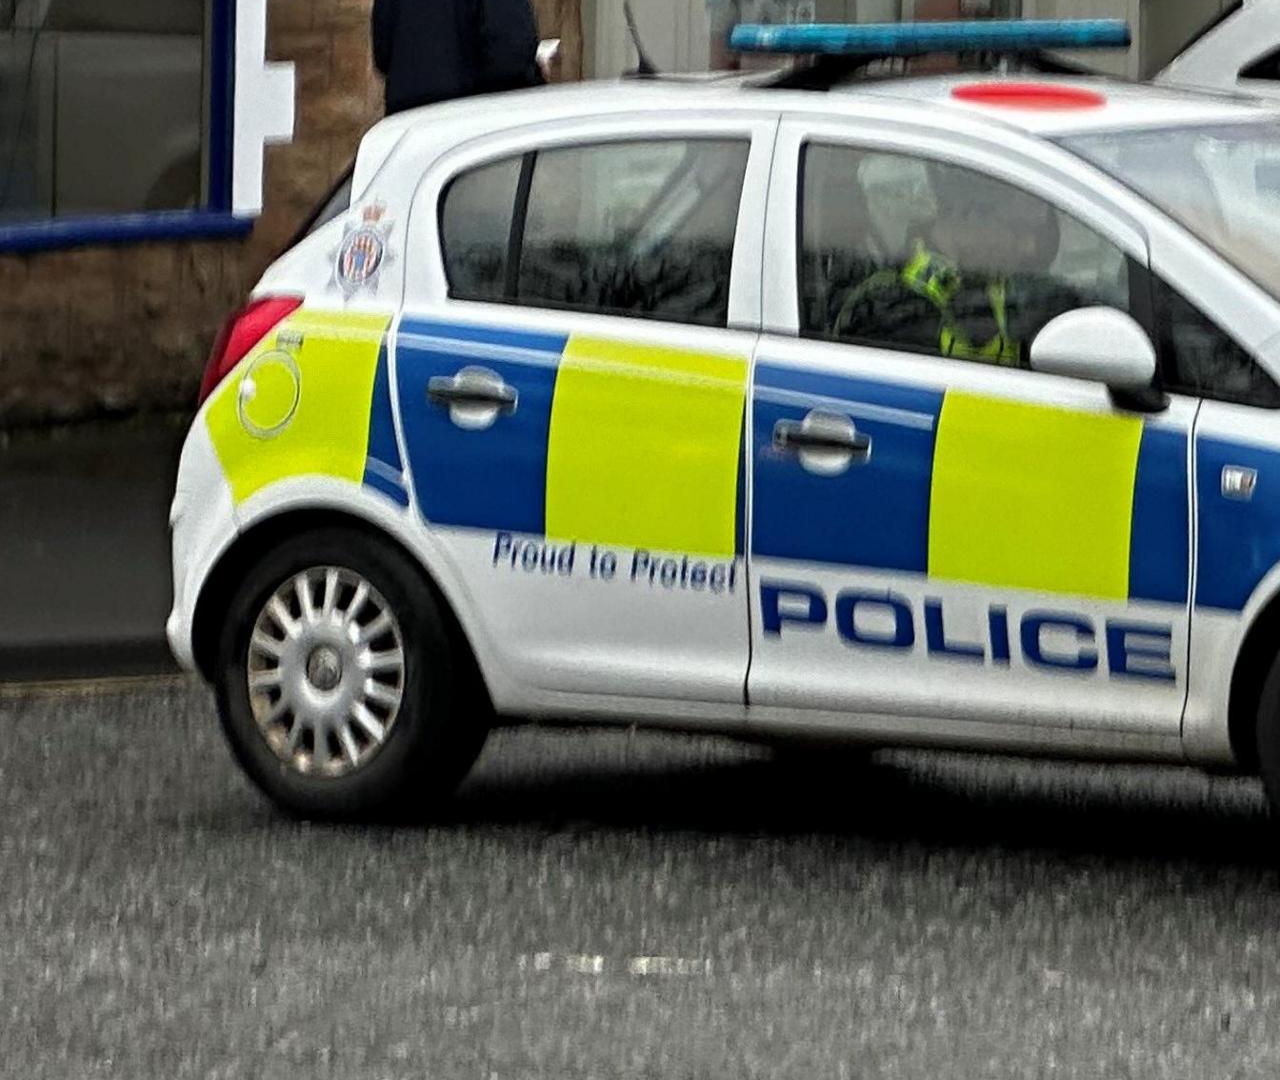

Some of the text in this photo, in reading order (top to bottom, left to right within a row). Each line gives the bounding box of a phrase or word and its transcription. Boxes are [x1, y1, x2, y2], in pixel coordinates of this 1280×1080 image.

[494, 531, 737, 594] Proud to Protect
[760, 576, 1178, 686] POLICE
